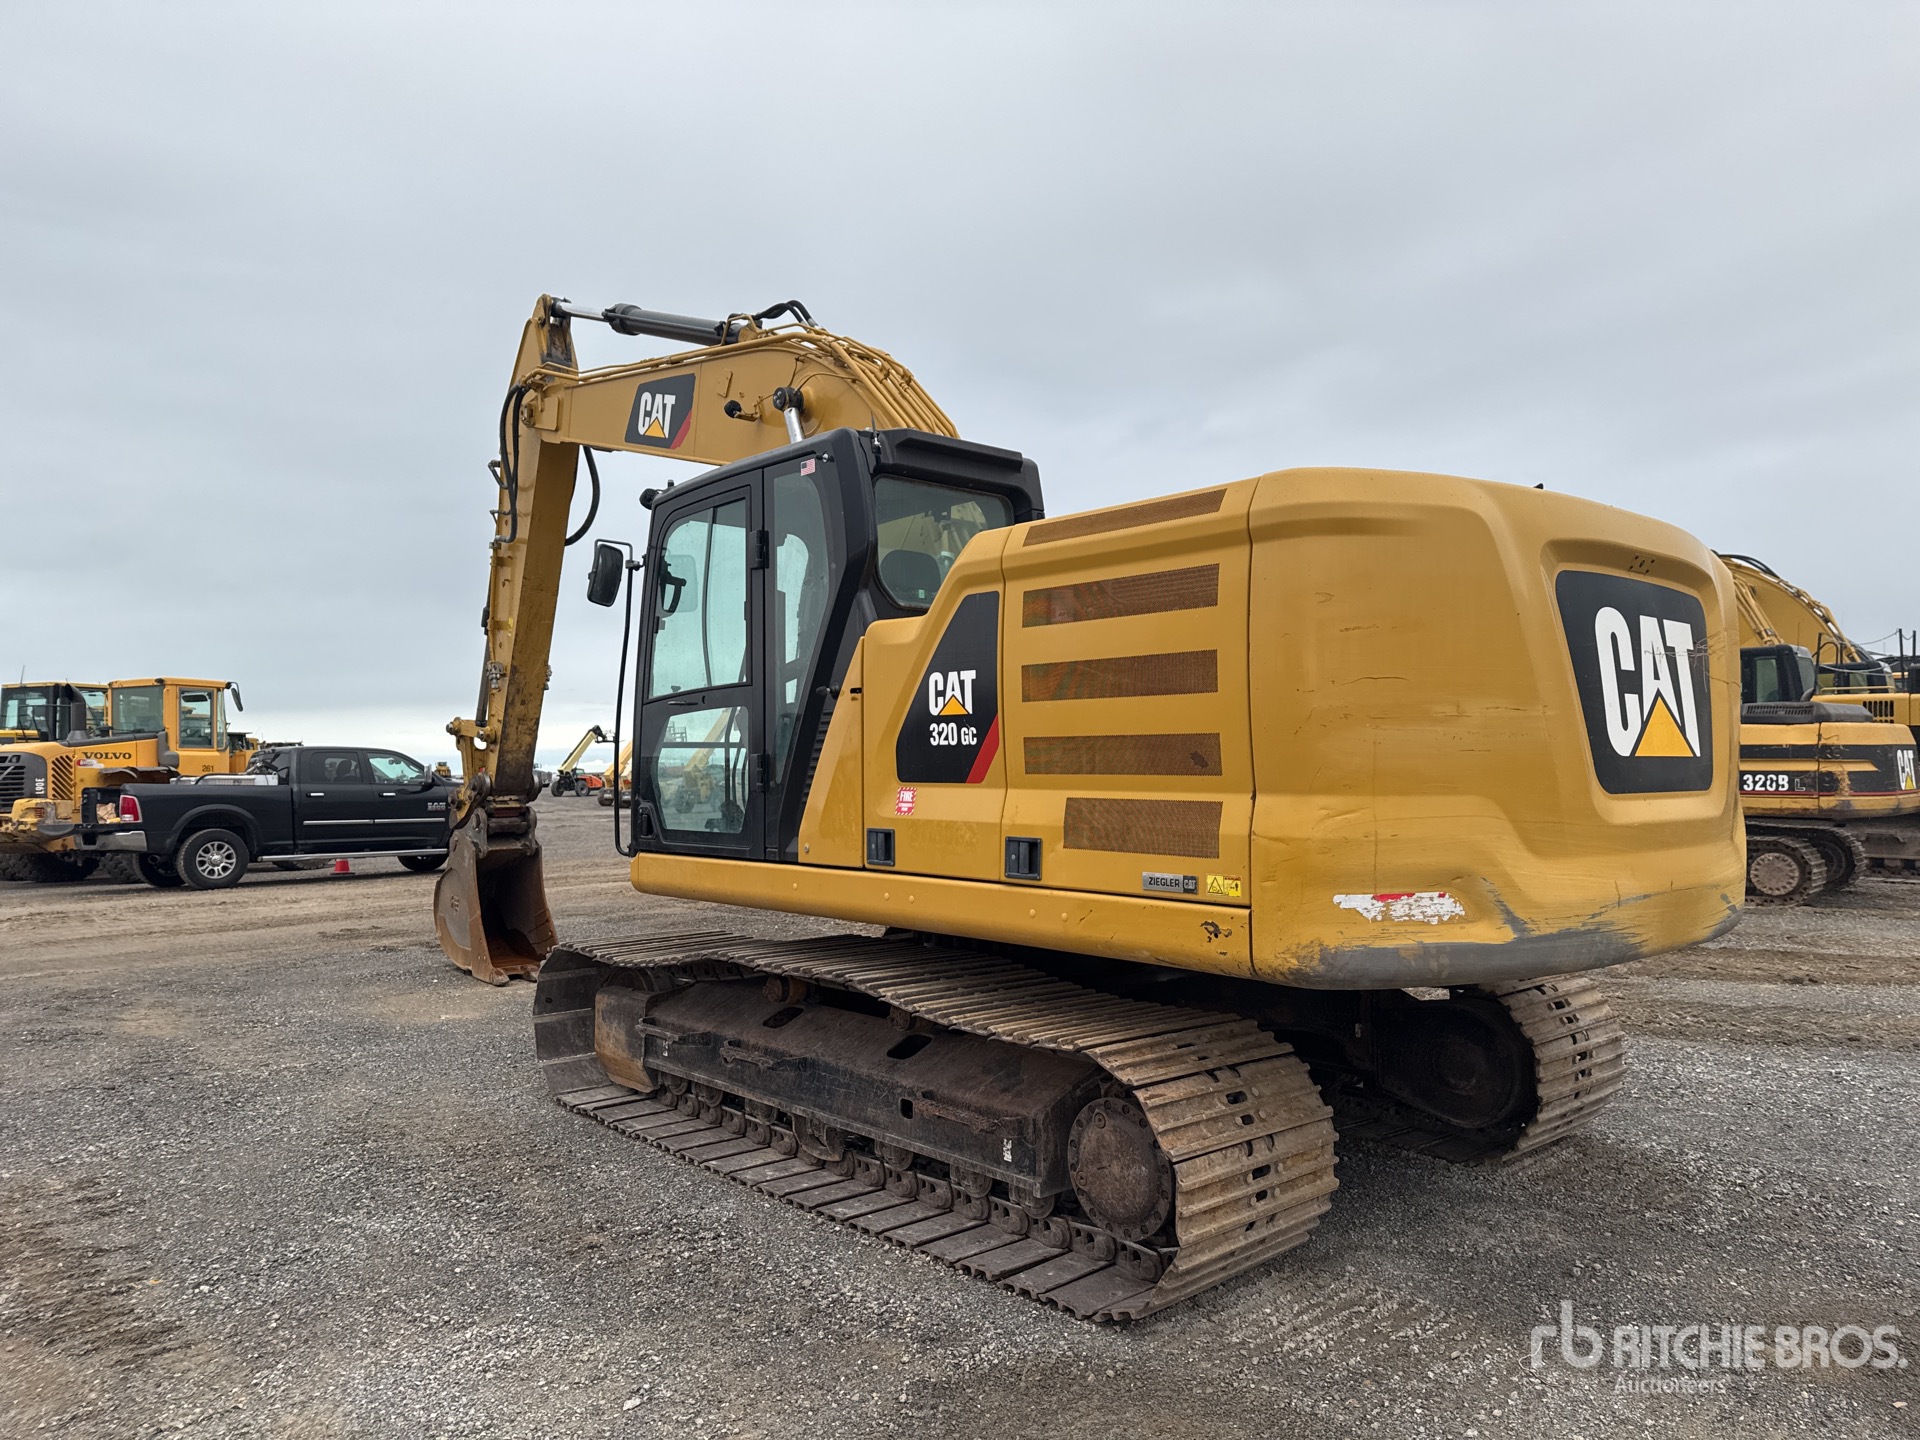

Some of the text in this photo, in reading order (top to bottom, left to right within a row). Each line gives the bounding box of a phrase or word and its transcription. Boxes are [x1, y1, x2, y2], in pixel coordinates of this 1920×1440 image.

[638, 391, 676, 439] CAT
[1594, 606, 1701, 757] CAT
[928, 669, 977, 716] CAT
[929, 722, 978, 746] 320 GC
[82, 752, 132, 760] VOLVO
[201, 764, 214, 773] 261
[1896, 749, 1917, 790] CAT
[34, 777, 45, 795] L90E
[1794, 778, 1806, 792] L
[1148, 876, 1197, 890] ZIEGLER CAT
